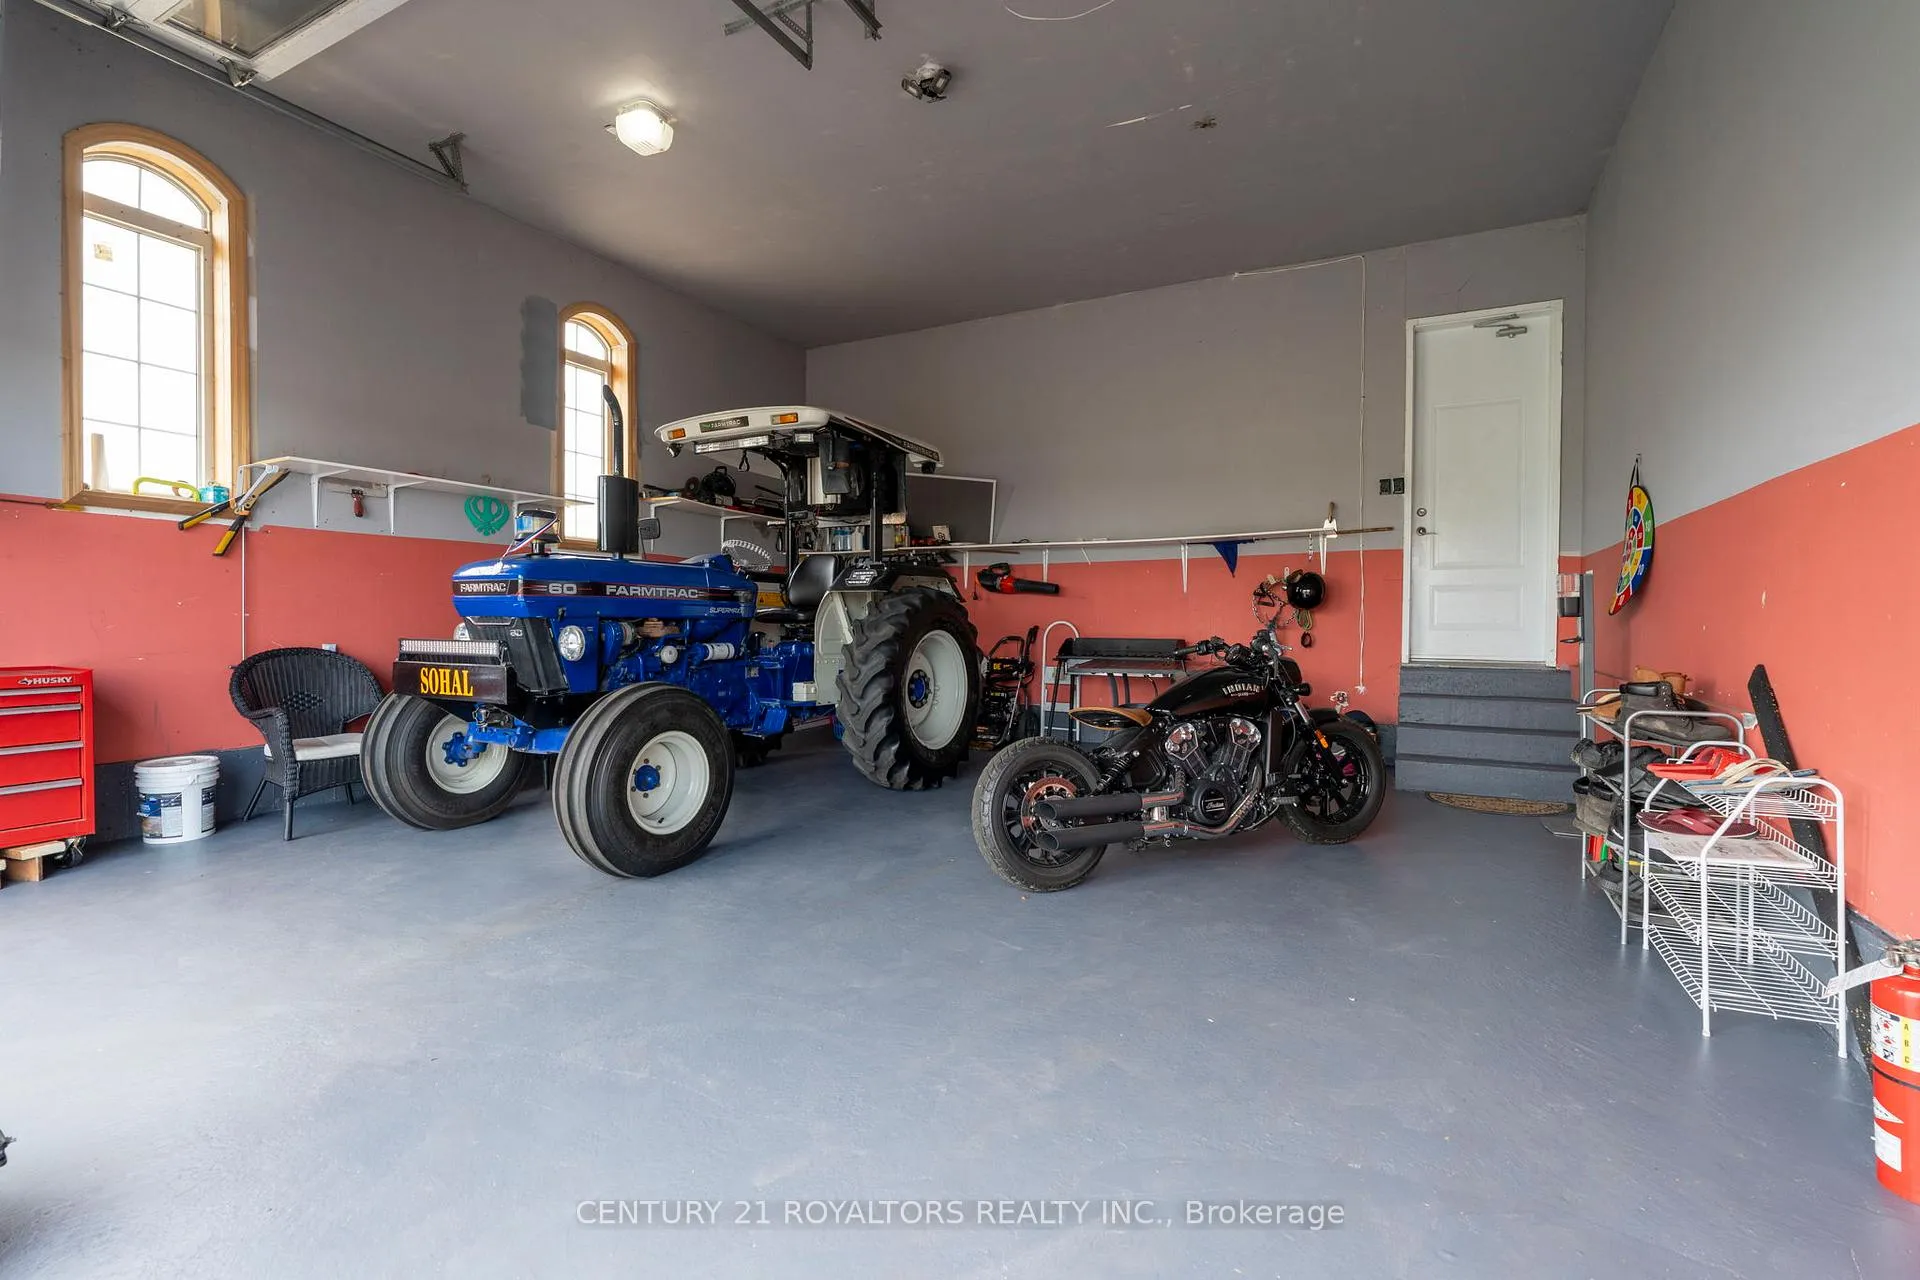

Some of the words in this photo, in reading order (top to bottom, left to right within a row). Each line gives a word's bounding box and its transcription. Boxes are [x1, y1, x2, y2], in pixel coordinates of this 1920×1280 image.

[460, 583, 508, 593] FARMTRAC
[548, 583, 578, 595] 60
[606, 585, 699, 599] FARMTRAC
[33, 676, 73, 684] HUSKY
[420, 667, 474, 697] SOHAL
[1904, 1023, 1909, 1032] A
[1904, 1039, 1909, 1047] B
